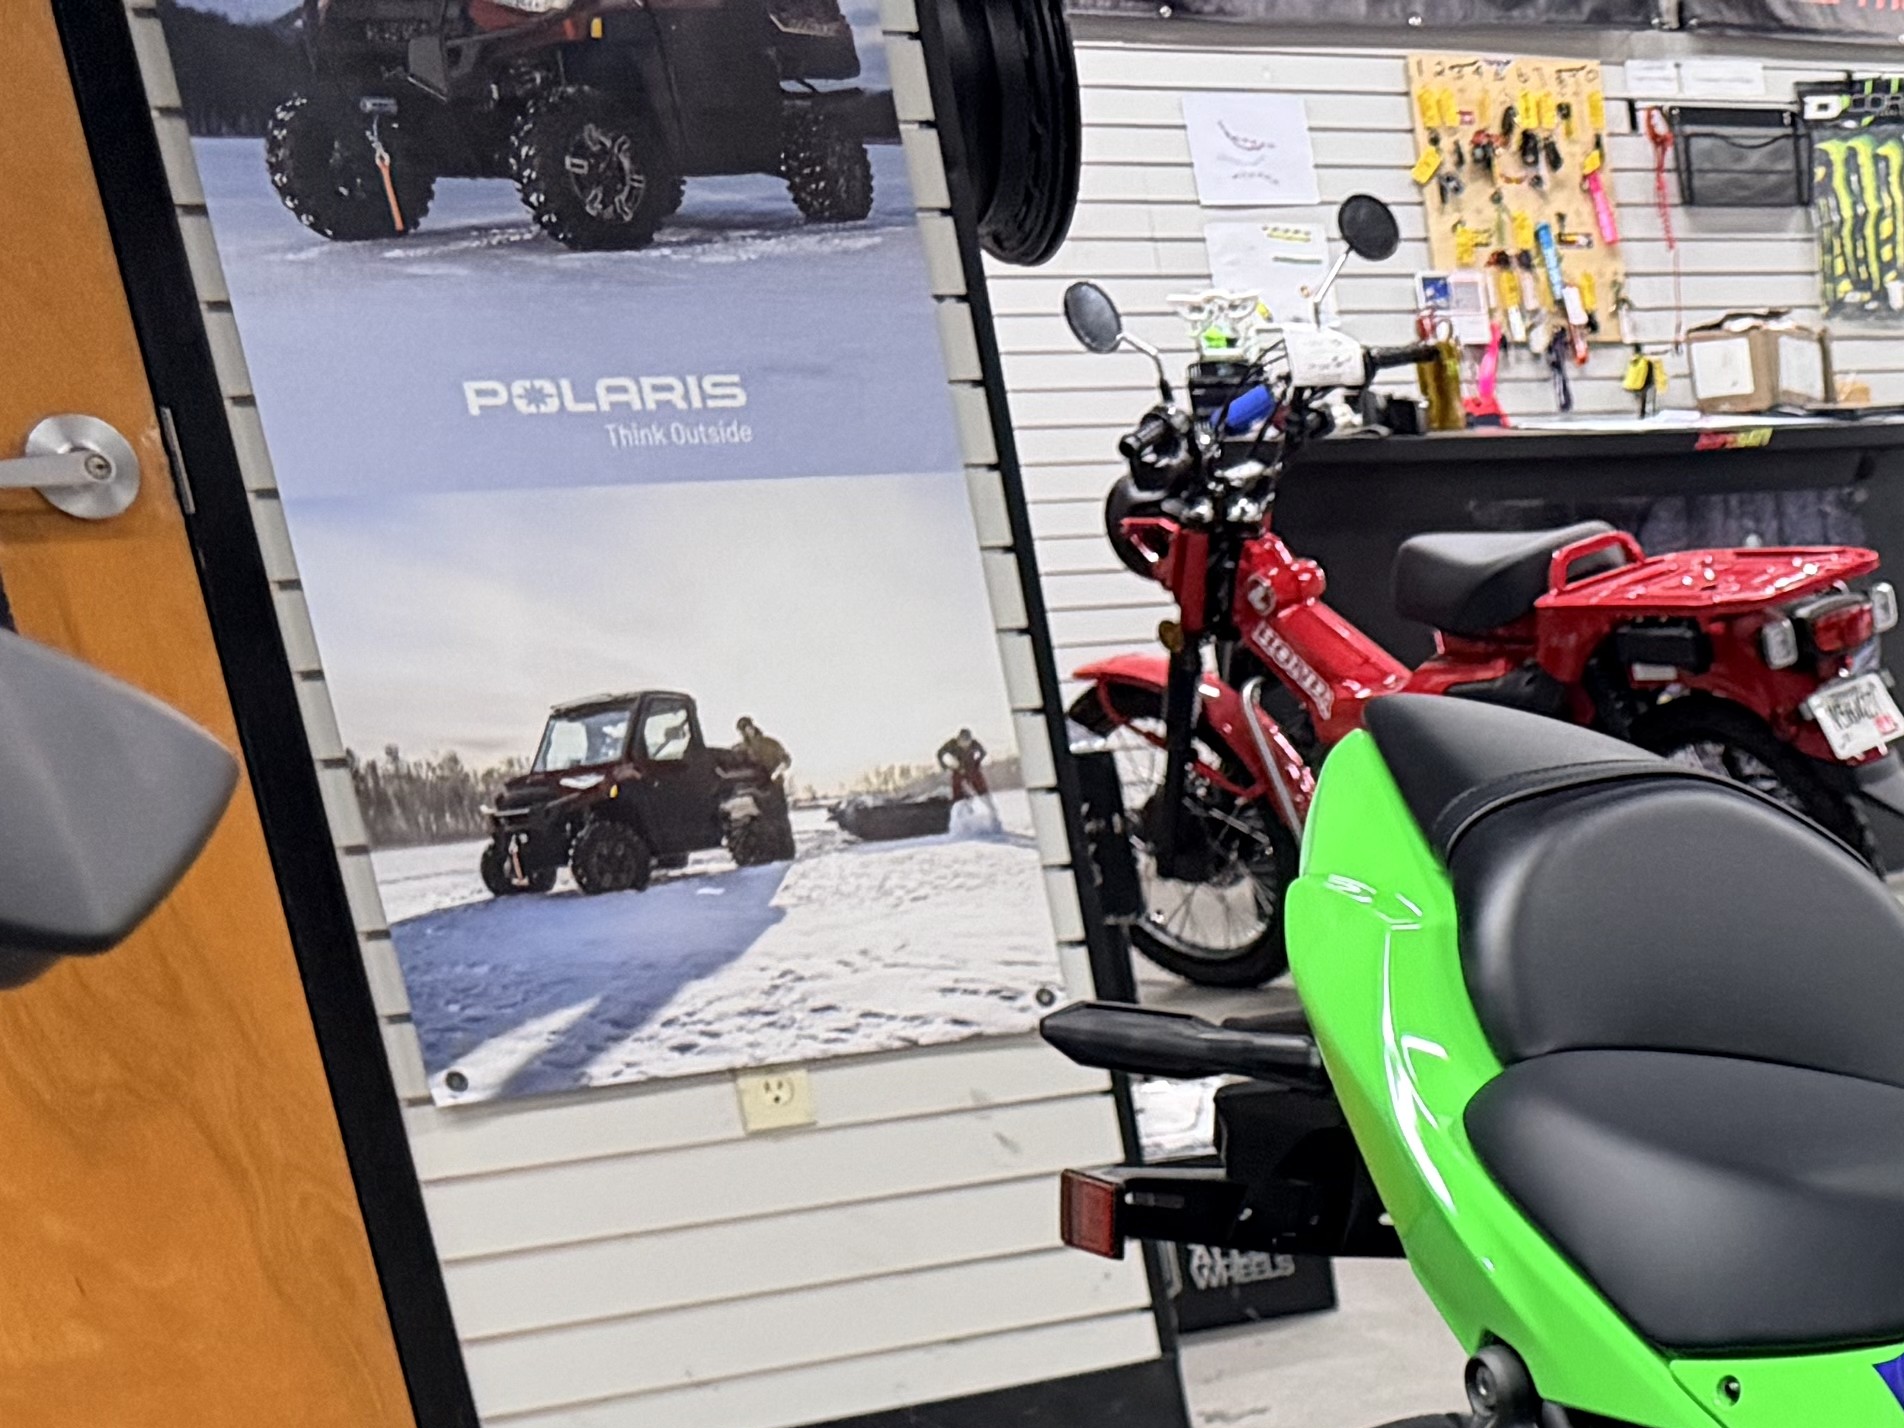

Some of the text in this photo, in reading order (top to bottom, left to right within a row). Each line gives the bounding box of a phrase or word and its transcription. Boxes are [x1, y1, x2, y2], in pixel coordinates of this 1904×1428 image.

[462, 374, 748, 416] POLARIS
[604, 419, 752, 448] Think Outside
